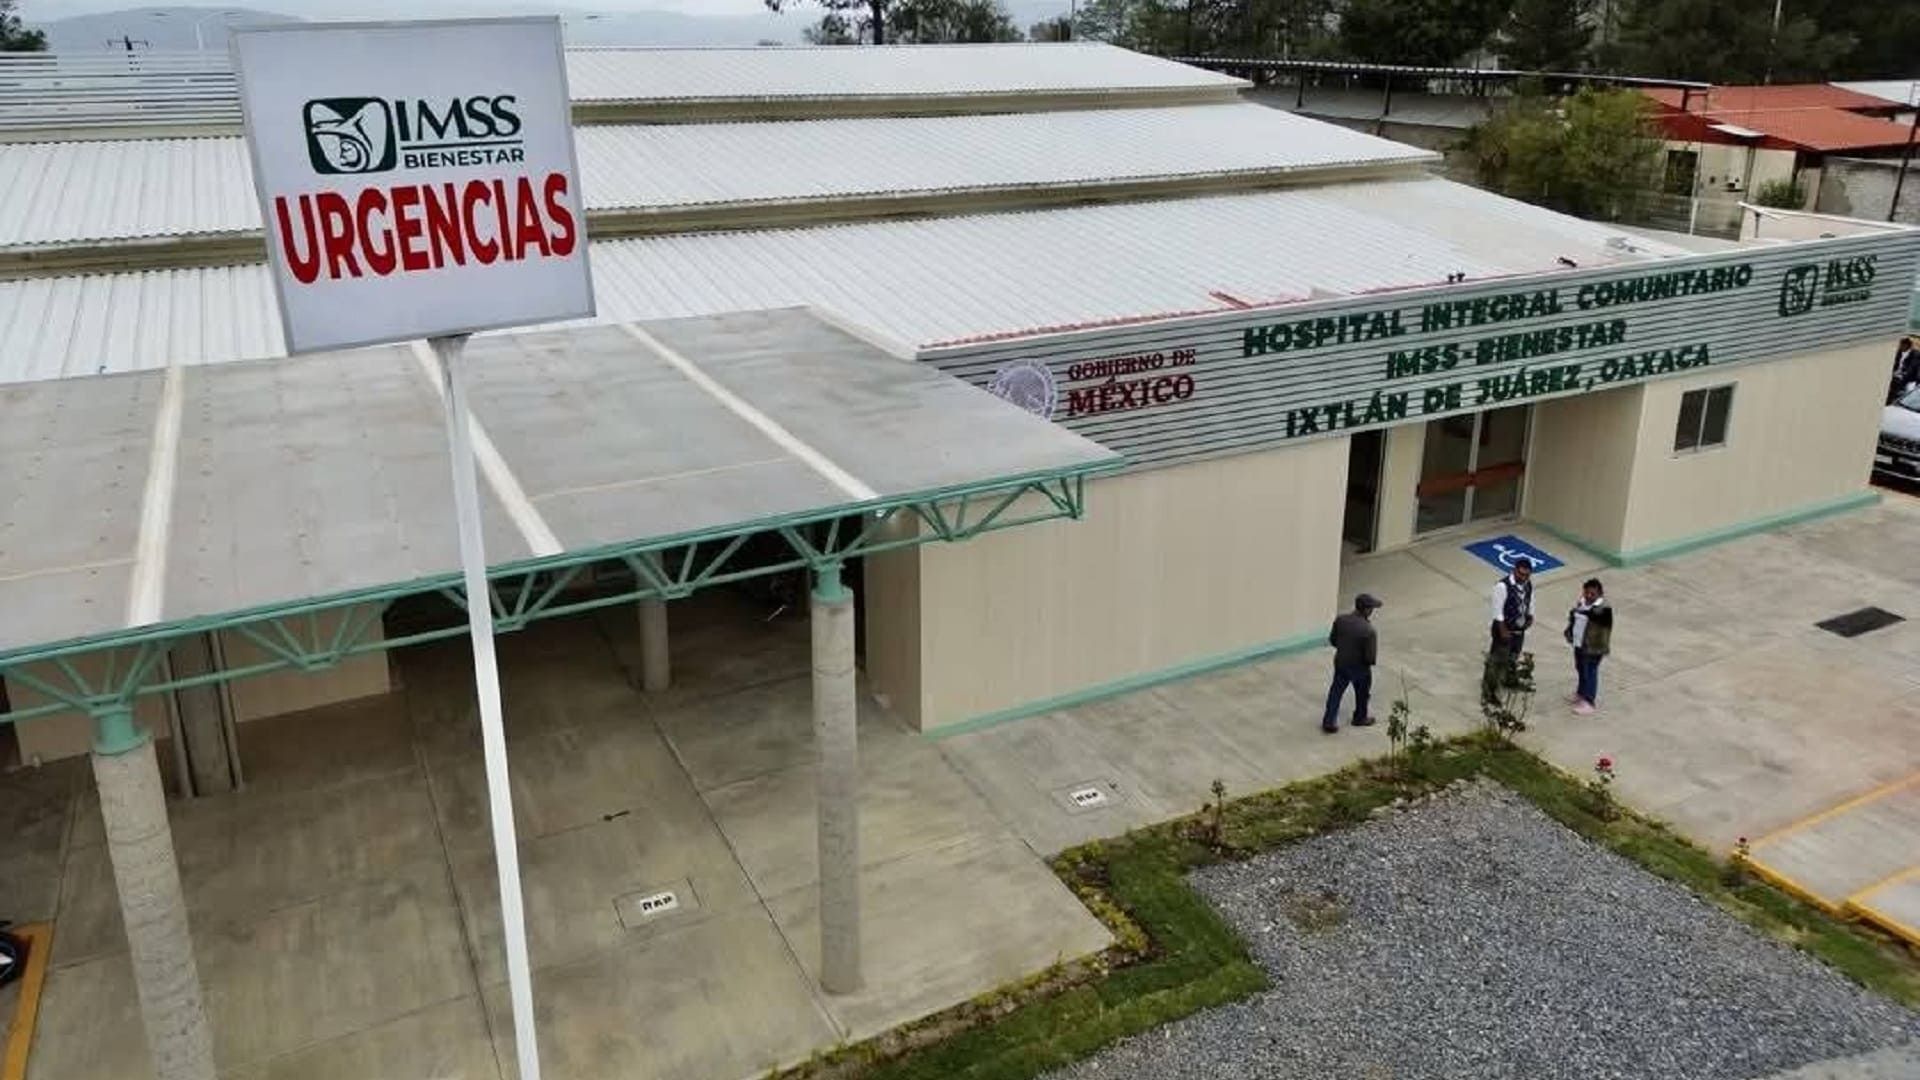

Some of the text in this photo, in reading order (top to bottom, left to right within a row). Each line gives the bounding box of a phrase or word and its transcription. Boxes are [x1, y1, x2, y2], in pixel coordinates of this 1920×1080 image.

[395, 96, 523, 141] IMSS
[404, 149, 525, 169] BIENESTAR
[275, 173, 576, 284] URGENCIAS
[1243, 263, 1753, 357] HOSPITAL INTEGRAL COMUNITARIO
[1068, 349, 1197, 381] GOBIERNO DE
[1386, 319, 1627, 379] IMSS-BIENESTAR
[1067, 375, 1196, 416] MÉXICO
[1286, 343, 1710, 438] IXTLÁN DE JUÁREZ, OAXACA
